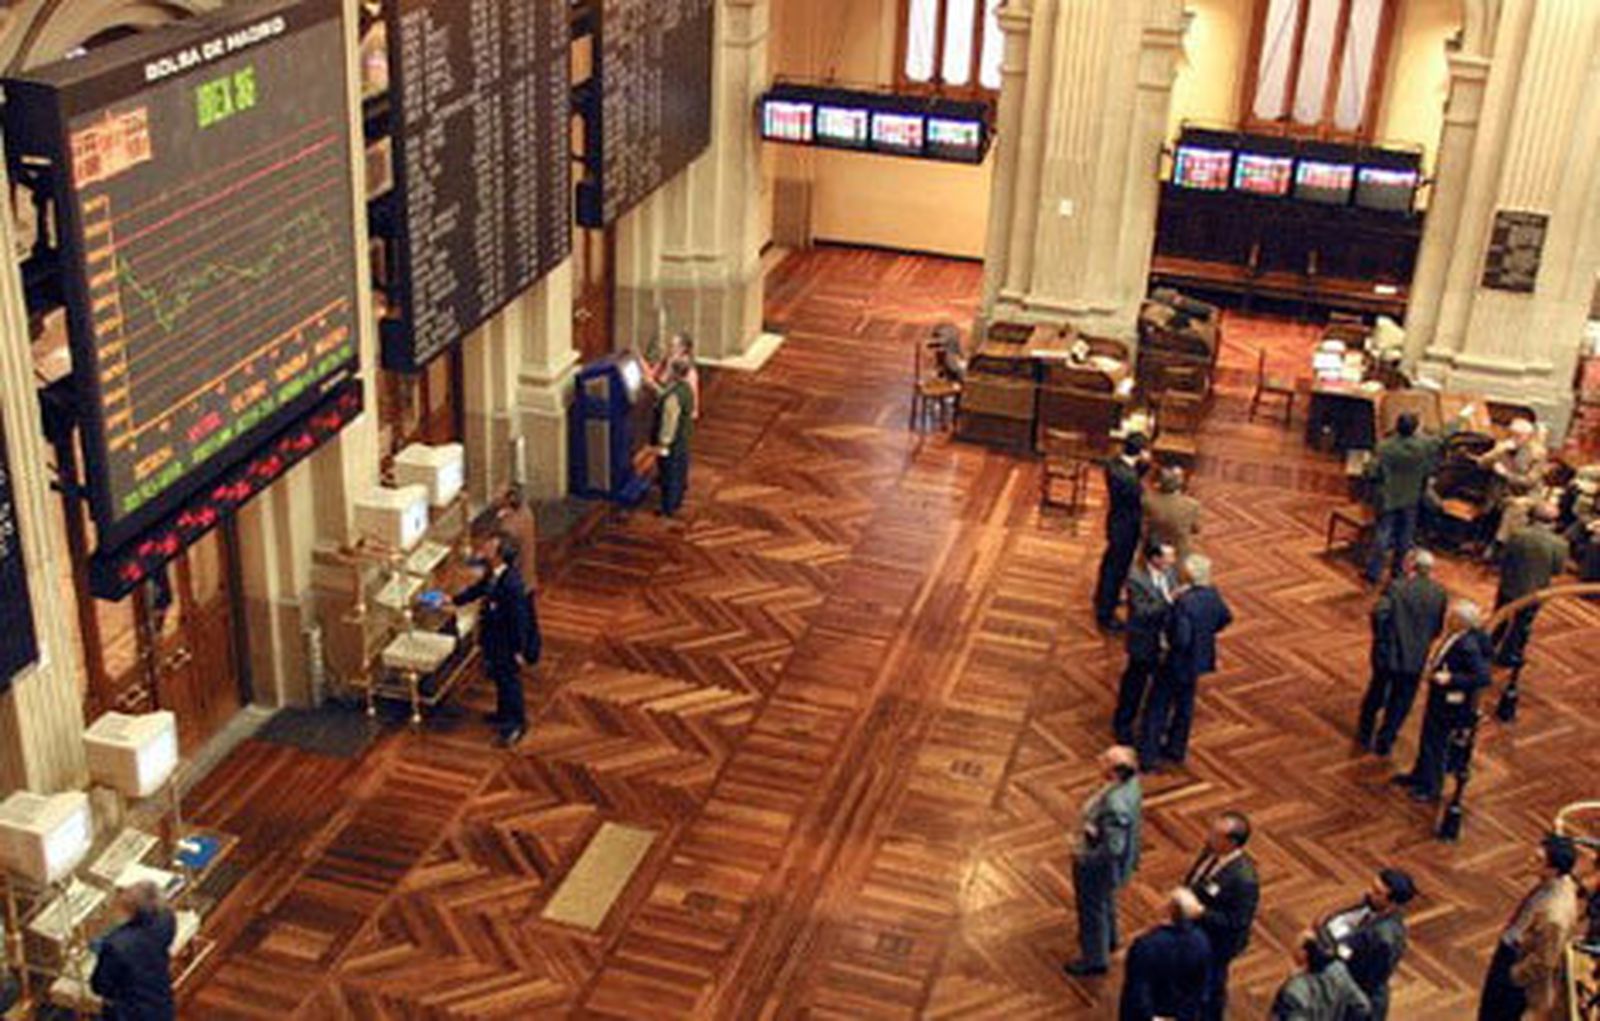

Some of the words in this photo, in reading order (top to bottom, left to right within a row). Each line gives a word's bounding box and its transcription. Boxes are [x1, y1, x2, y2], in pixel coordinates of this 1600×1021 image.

[145, 47, 201, 81] BOLSA
[202, 38, 225, 60] DE
[226, 16, 286, 52] MADRID
